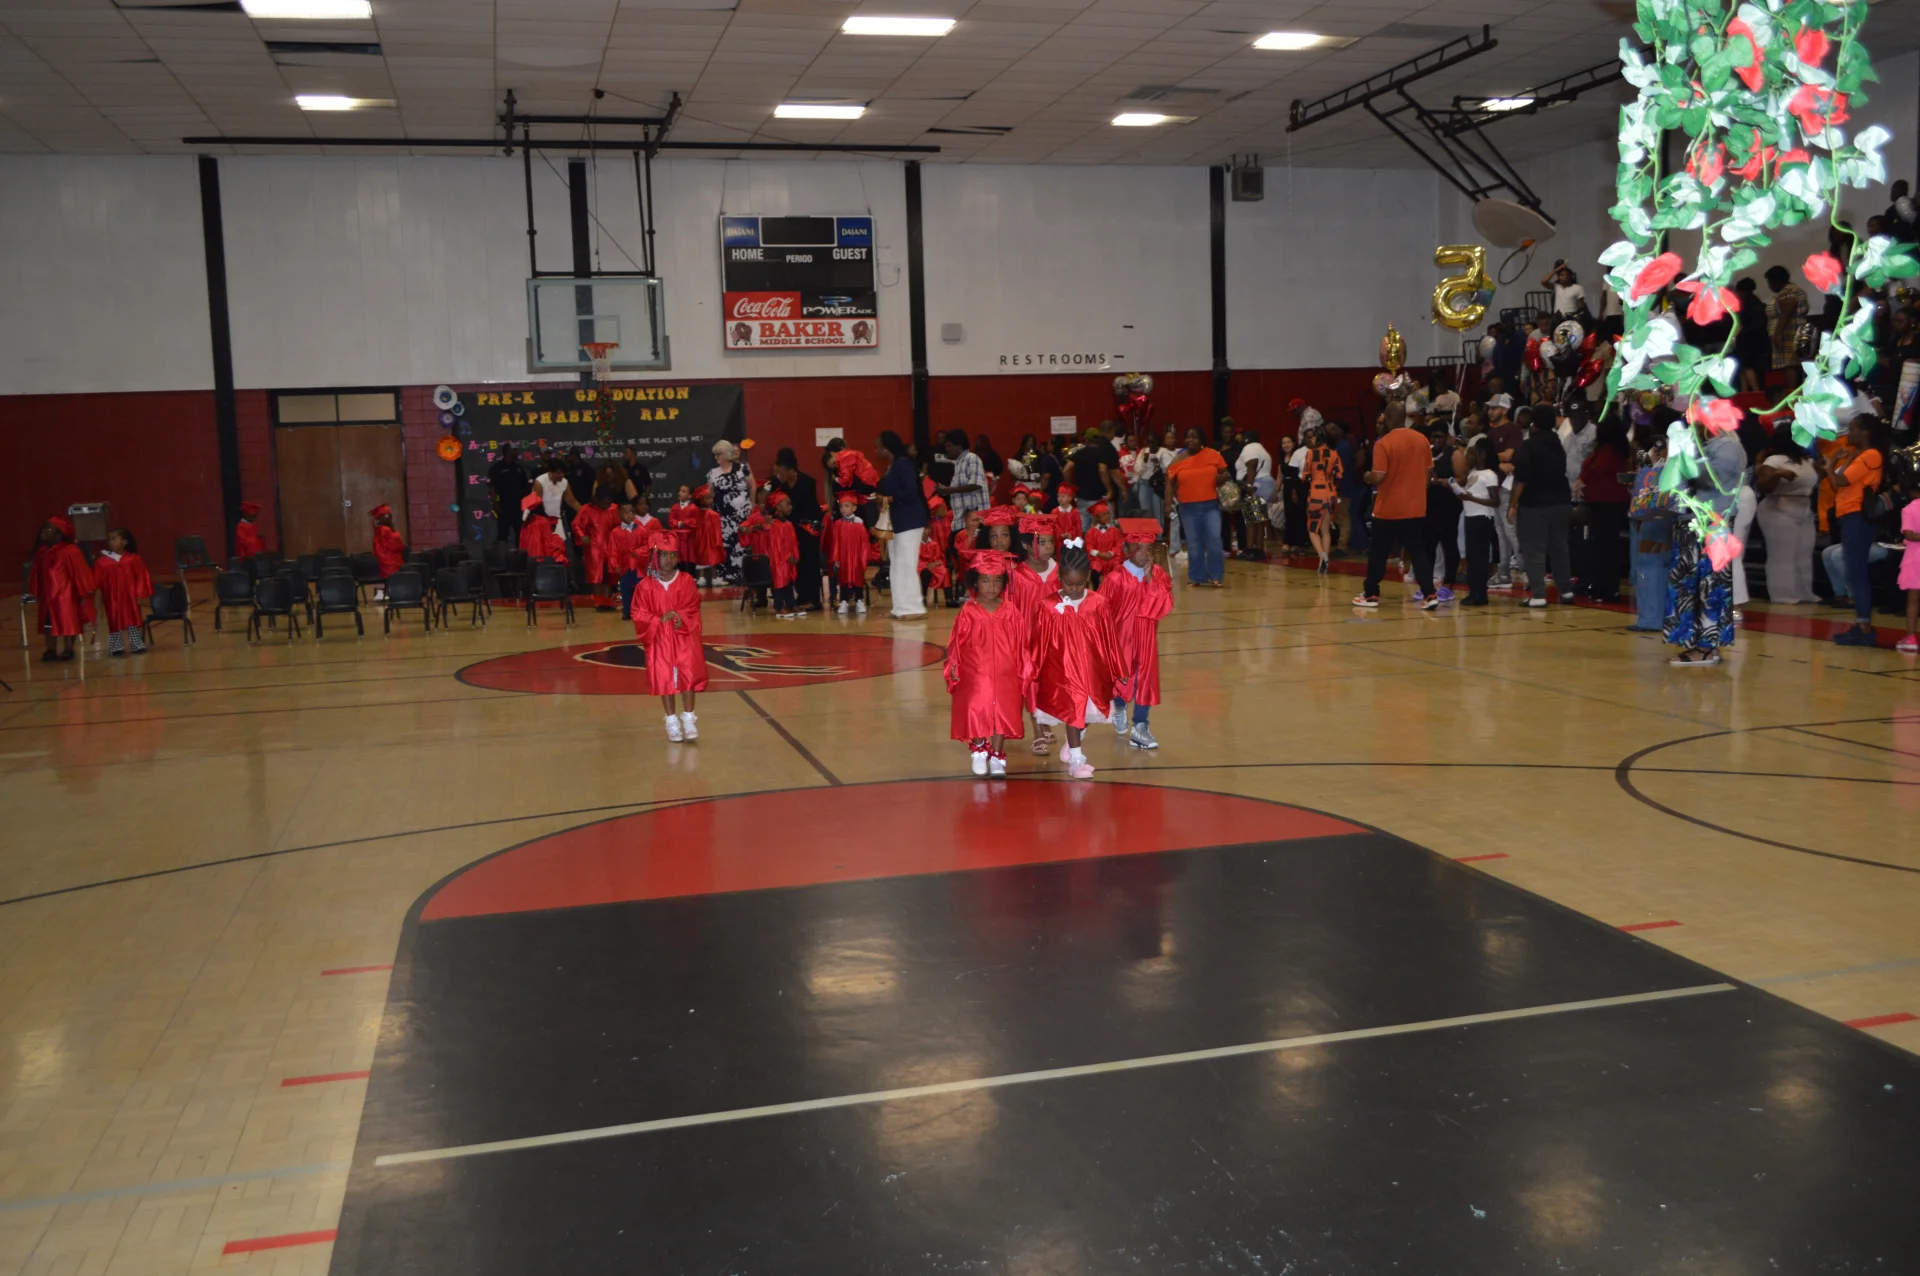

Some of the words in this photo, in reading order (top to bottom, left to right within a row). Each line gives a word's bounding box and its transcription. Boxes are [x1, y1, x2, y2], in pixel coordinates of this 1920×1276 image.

[731, 249, 764, 260] HOME
[786, 254, 813, 263] PERIOD
[833, 248, 867, 260] GUEST
[733, 297, 794, 319] Coca-Cola
[759, 322, 844, 338] BAKER
[759, 338, 801, 346] MIDDLE
[804, 337, 846, 345] SCHOOL
[999, 354, 1106, 366] RESTROOMS
[477, 391, 535, 406] PRE-K
[575, 387, 690, 402] GRDUATION
[640, 407, 680, 421] RAP
